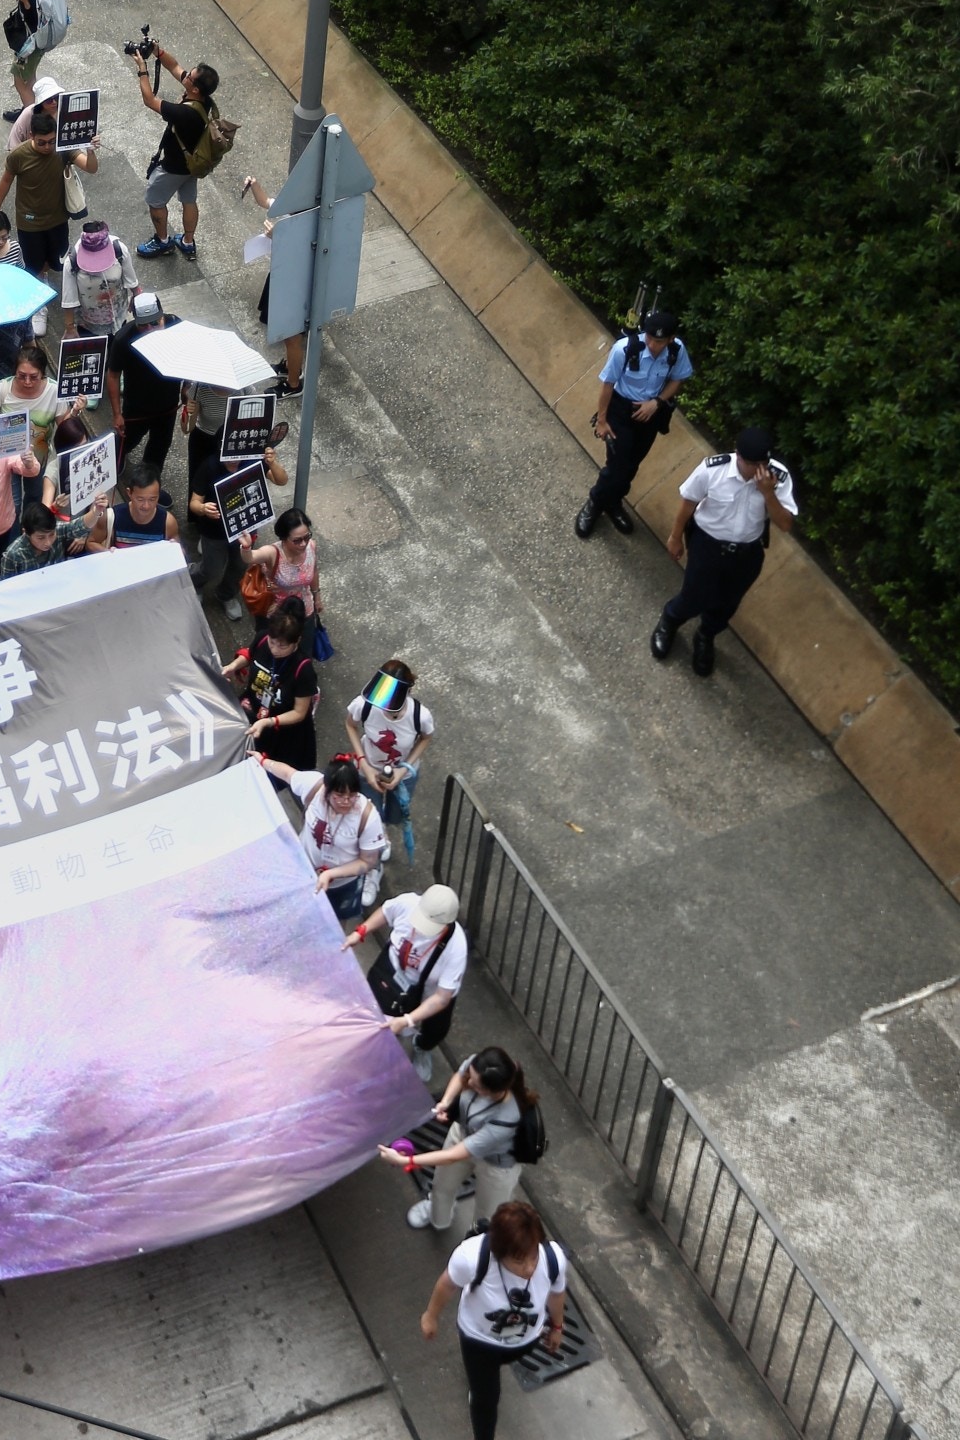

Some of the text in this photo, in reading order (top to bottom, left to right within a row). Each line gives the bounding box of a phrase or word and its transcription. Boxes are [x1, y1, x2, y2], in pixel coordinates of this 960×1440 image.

[61, 119, 96, 131] 虐待動物
[61, 129, 95, 141] 監禁十年
[228, 429, 269, 439] 虐待動物
[227, 439, 267, 450] 監禁十年
